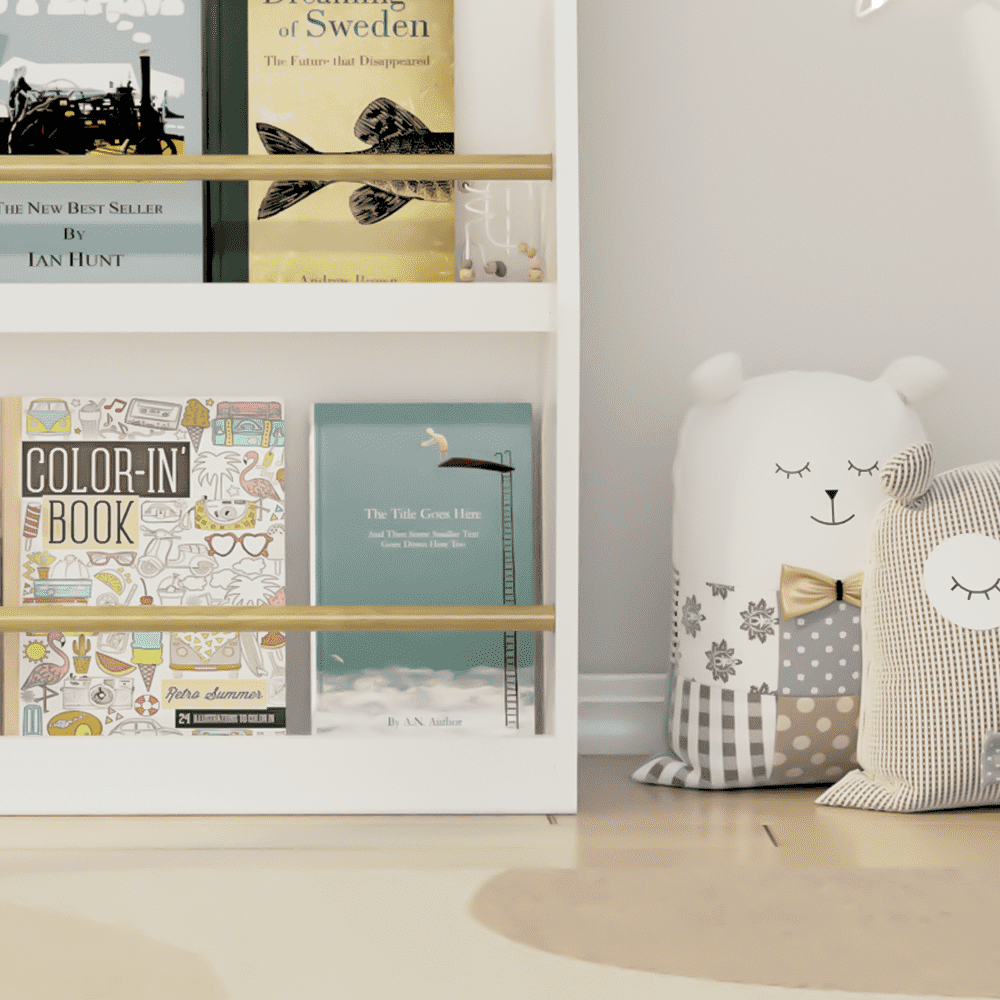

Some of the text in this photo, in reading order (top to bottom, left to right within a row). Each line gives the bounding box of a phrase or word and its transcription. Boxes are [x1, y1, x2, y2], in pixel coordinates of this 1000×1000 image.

[278, 8, 430, 38] of Sweden
[263, 55, 431, 69] The Future that Disappeared
[364, 508, 481, 519] The Title Goes Here
[48, 500, 135, 545] BOOK
[165, 686, 263, 703] Retro Summer
[178, 712, 191, 724] 24
[387, 716, 399, 729] By
[428, 716, 462, 727] Author
